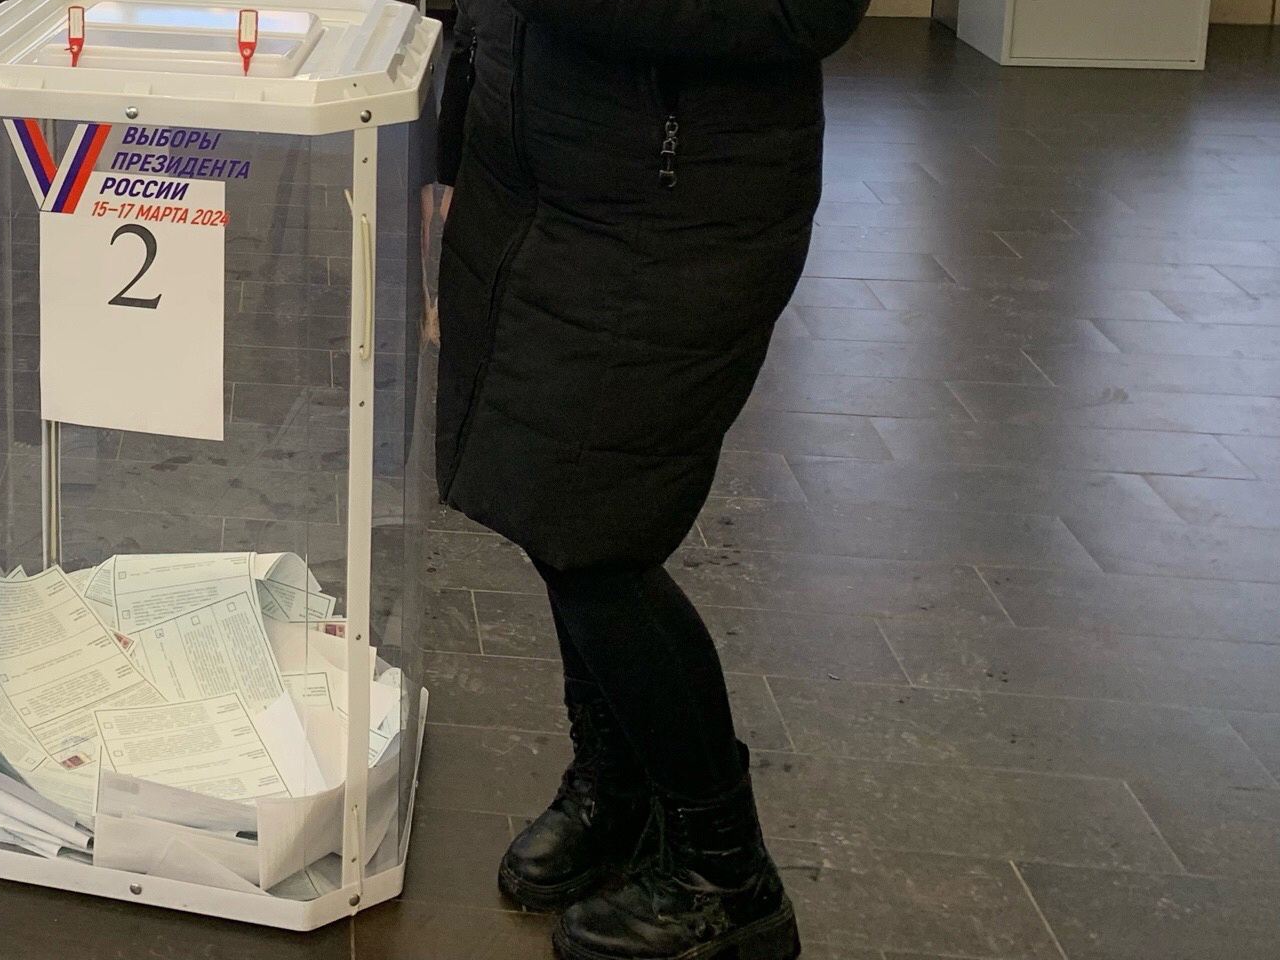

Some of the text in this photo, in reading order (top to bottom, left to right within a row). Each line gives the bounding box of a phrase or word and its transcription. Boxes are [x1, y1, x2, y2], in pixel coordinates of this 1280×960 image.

[122, 126, 222, 151] ВЫБОРЫ
[111, 152, 251, 180] ПРЕЗИДЕНТА
[99, 177, 190, 201] РОССИИ
[136, 206, 189, 225] МАРТА
[191, 209, 230, 228] 2024
[108, 223, 162, 310] 2
